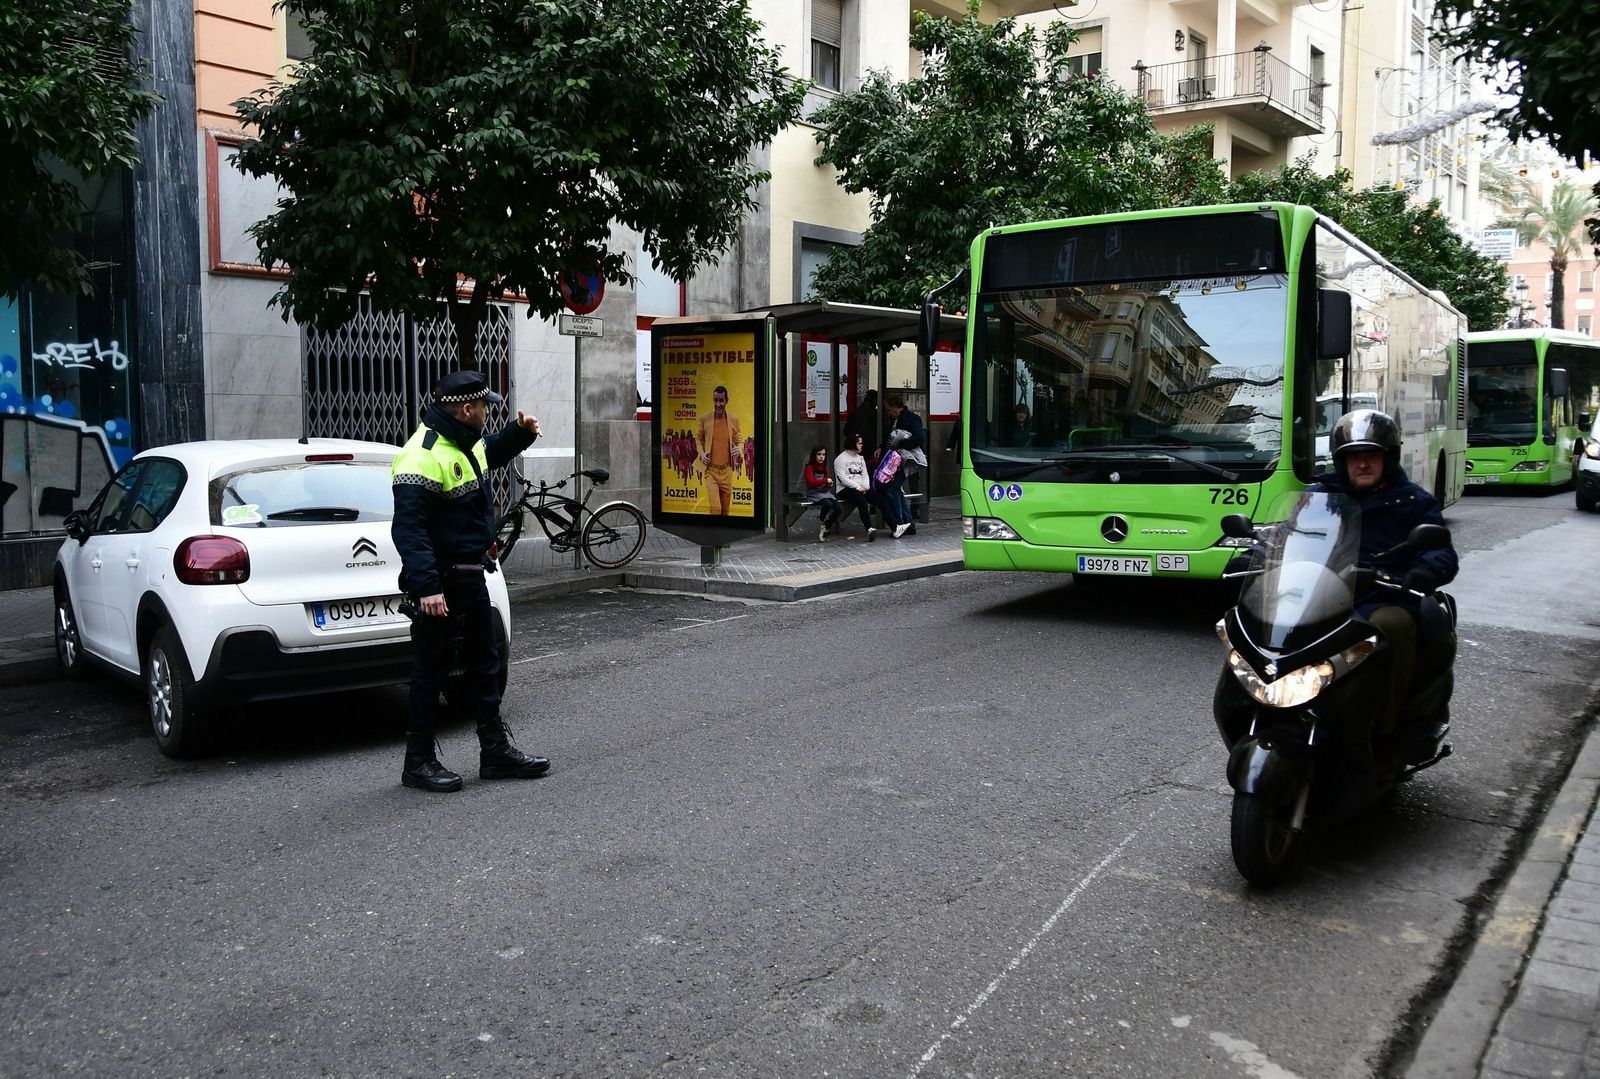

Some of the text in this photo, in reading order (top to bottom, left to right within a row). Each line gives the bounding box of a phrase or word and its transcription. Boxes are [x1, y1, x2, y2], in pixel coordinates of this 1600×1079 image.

[572, 317, 593, 325] EXCEPTO
[663, 350, 754, 365] IRRESISTIBLE
[808, 352, 816, 364] 12
[681, 368, 697, 376] Móvil
[667, 377, 690, 386] 25GB
[667, 386, 697, 395] 2 líneas
[1511, 448, 1527, 456] 725
[664, 486, 697, 498] Jazztel
[732, 491, 752, 501] 1568
[1208, 488, 1249, 505] 726
[345, 560, 386, 568] CITROËN
[1087, 558, 1149, 573] 9978 FNZ
[1160, 556, 1185, 569] SP
[329, 600, 378, 620] 0902
